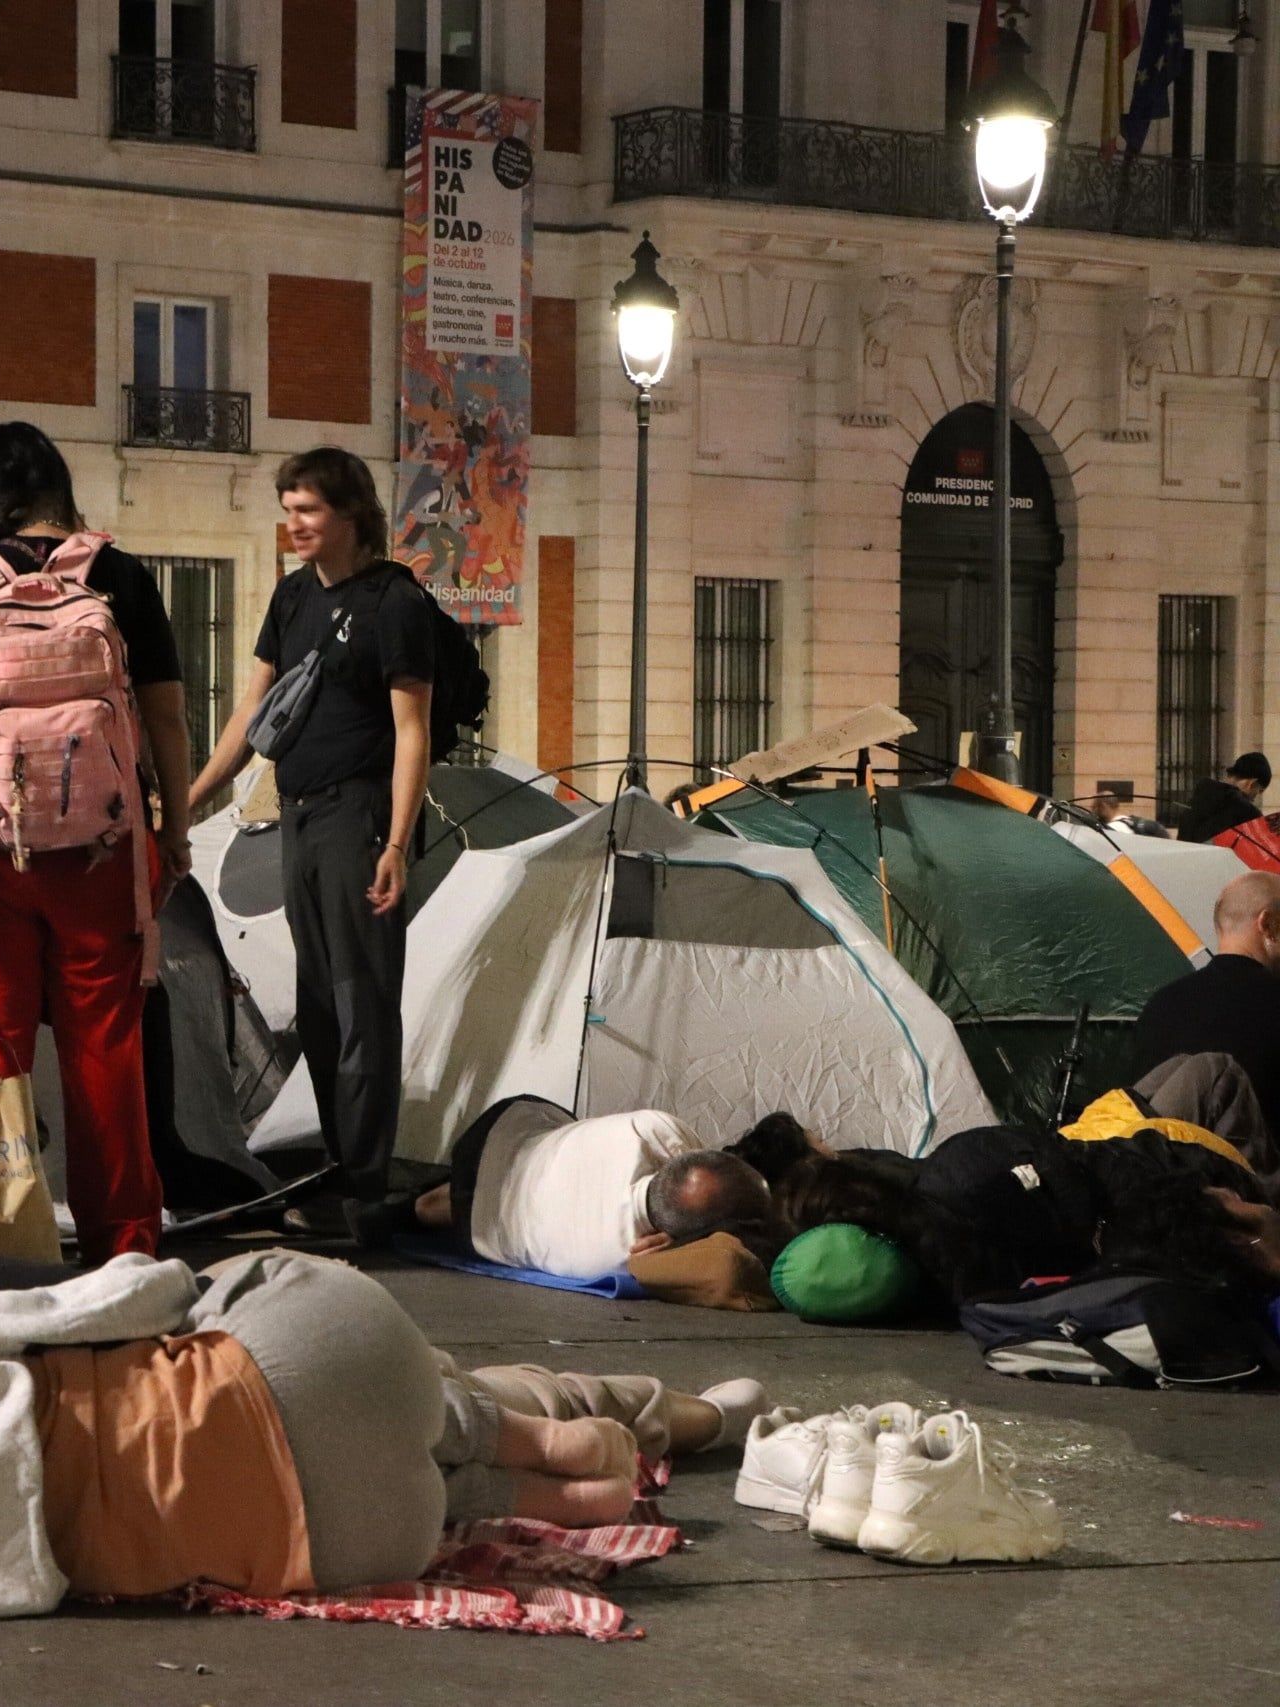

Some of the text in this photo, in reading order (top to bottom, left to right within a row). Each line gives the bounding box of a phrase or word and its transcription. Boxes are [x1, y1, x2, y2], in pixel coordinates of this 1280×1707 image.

[434, 146, 473, 170] HIS
[434, 170, 465, 194] PA
[434, 193, 458, 217] NI
[434, 218, 515, 246] DAD 2026
[433, 244, 484, 258] Del 2 al 12
[433, 256, 487, 271] de octubre
[466, 281, 494, 292] danza,
[433, 292, 516, 308] teatro, conferencias,
[432, 305, 487, 320] folclore, cine,
[432, 319, 483, 332] gastronomía
[432, 333, 438, 343] y
[438, 334, 467, 345] mucho
[468, 335, 489, 346] más.
[935, 477, 994, 491] PRESIDENC
[906, 492, 1034, 509] COMUNIDAD DE DRID
